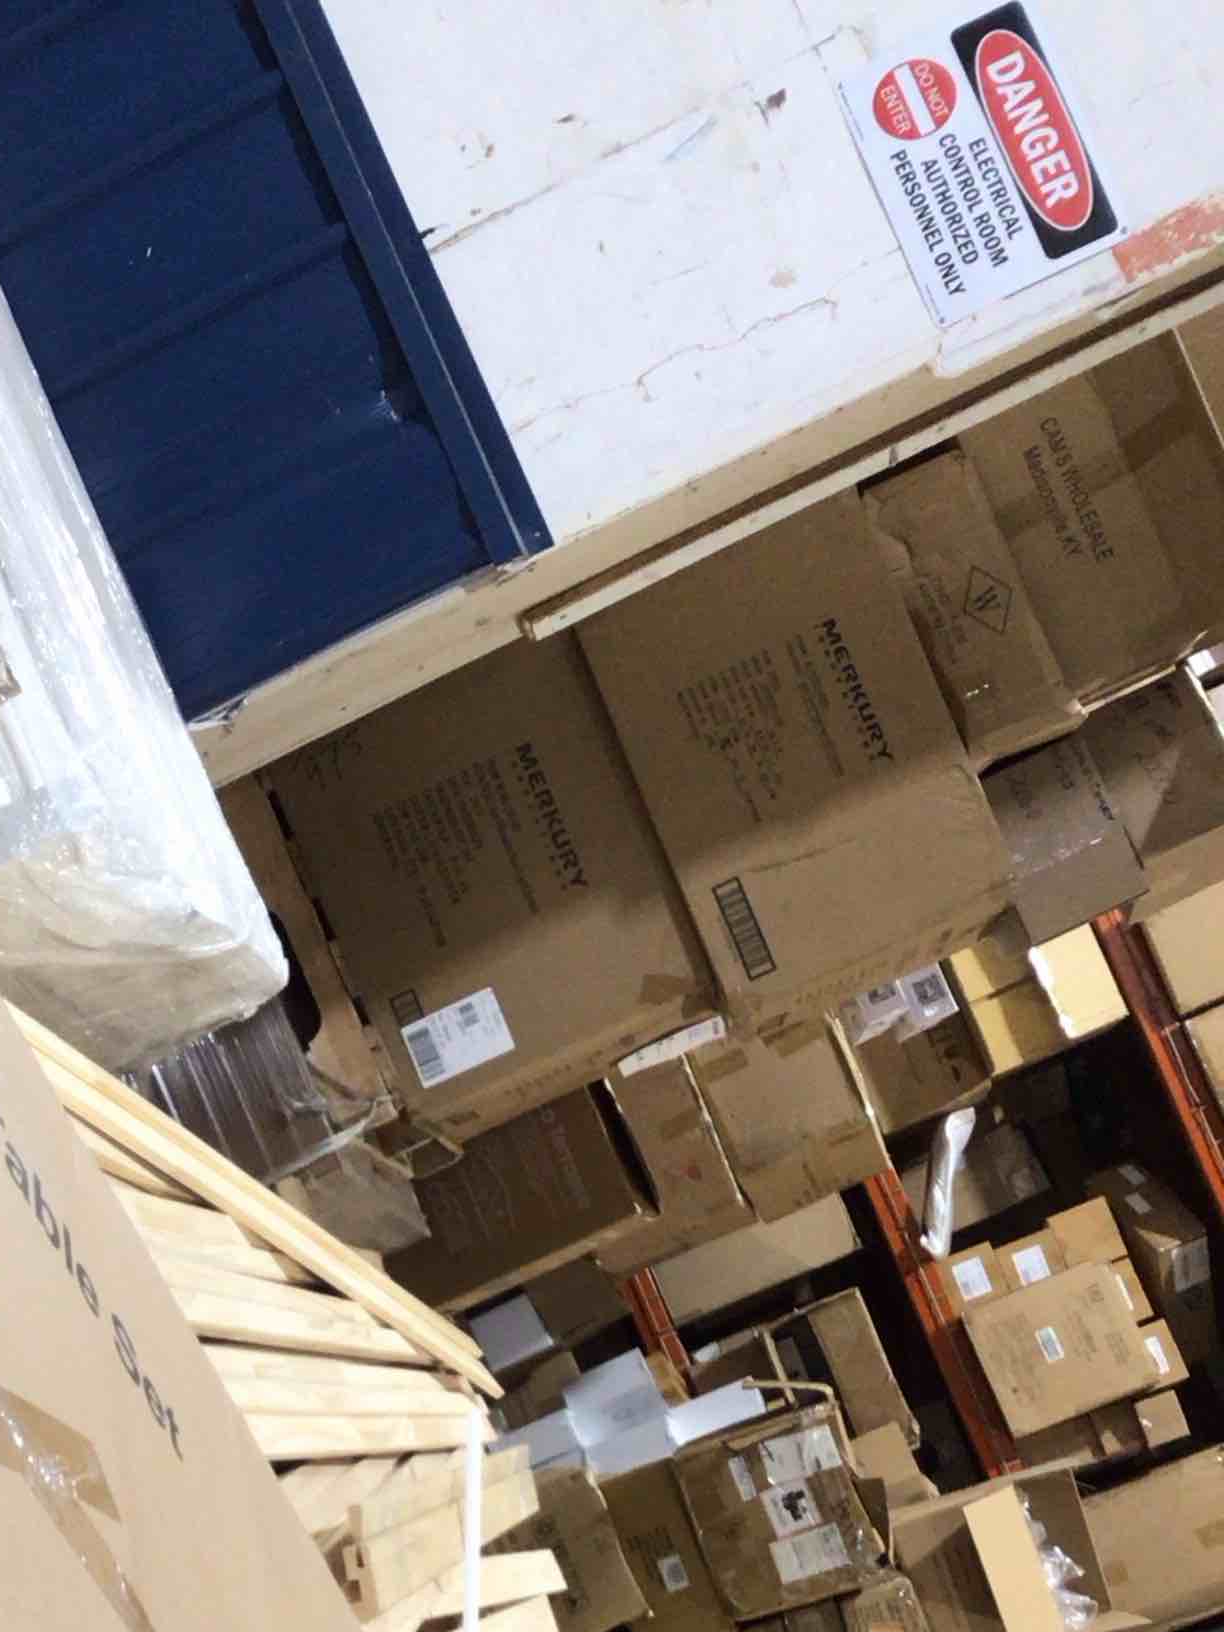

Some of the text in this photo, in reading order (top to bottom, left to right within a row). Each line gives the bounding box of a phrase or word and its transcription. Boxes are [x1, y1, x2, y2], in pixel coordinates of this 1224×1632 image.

[880, 86, 913, 134] ENTER
[912, 64, 949, 118] DO NOT
[985, 50, 1081, 210] DANGER
[890, 151, 967, 297] PERSONNEL ONLY
[920, 159, 979, 265] AUTHORIZED
[939, 133, 1008, 268] CONTROL ROOM
[968, 140, 1026, 240] ELECTRICAL
[818, 617, 895, 762] MERKURY
[516, 743, 588, 888] MERKURY
[110, 1312, 185, 1459] Set
